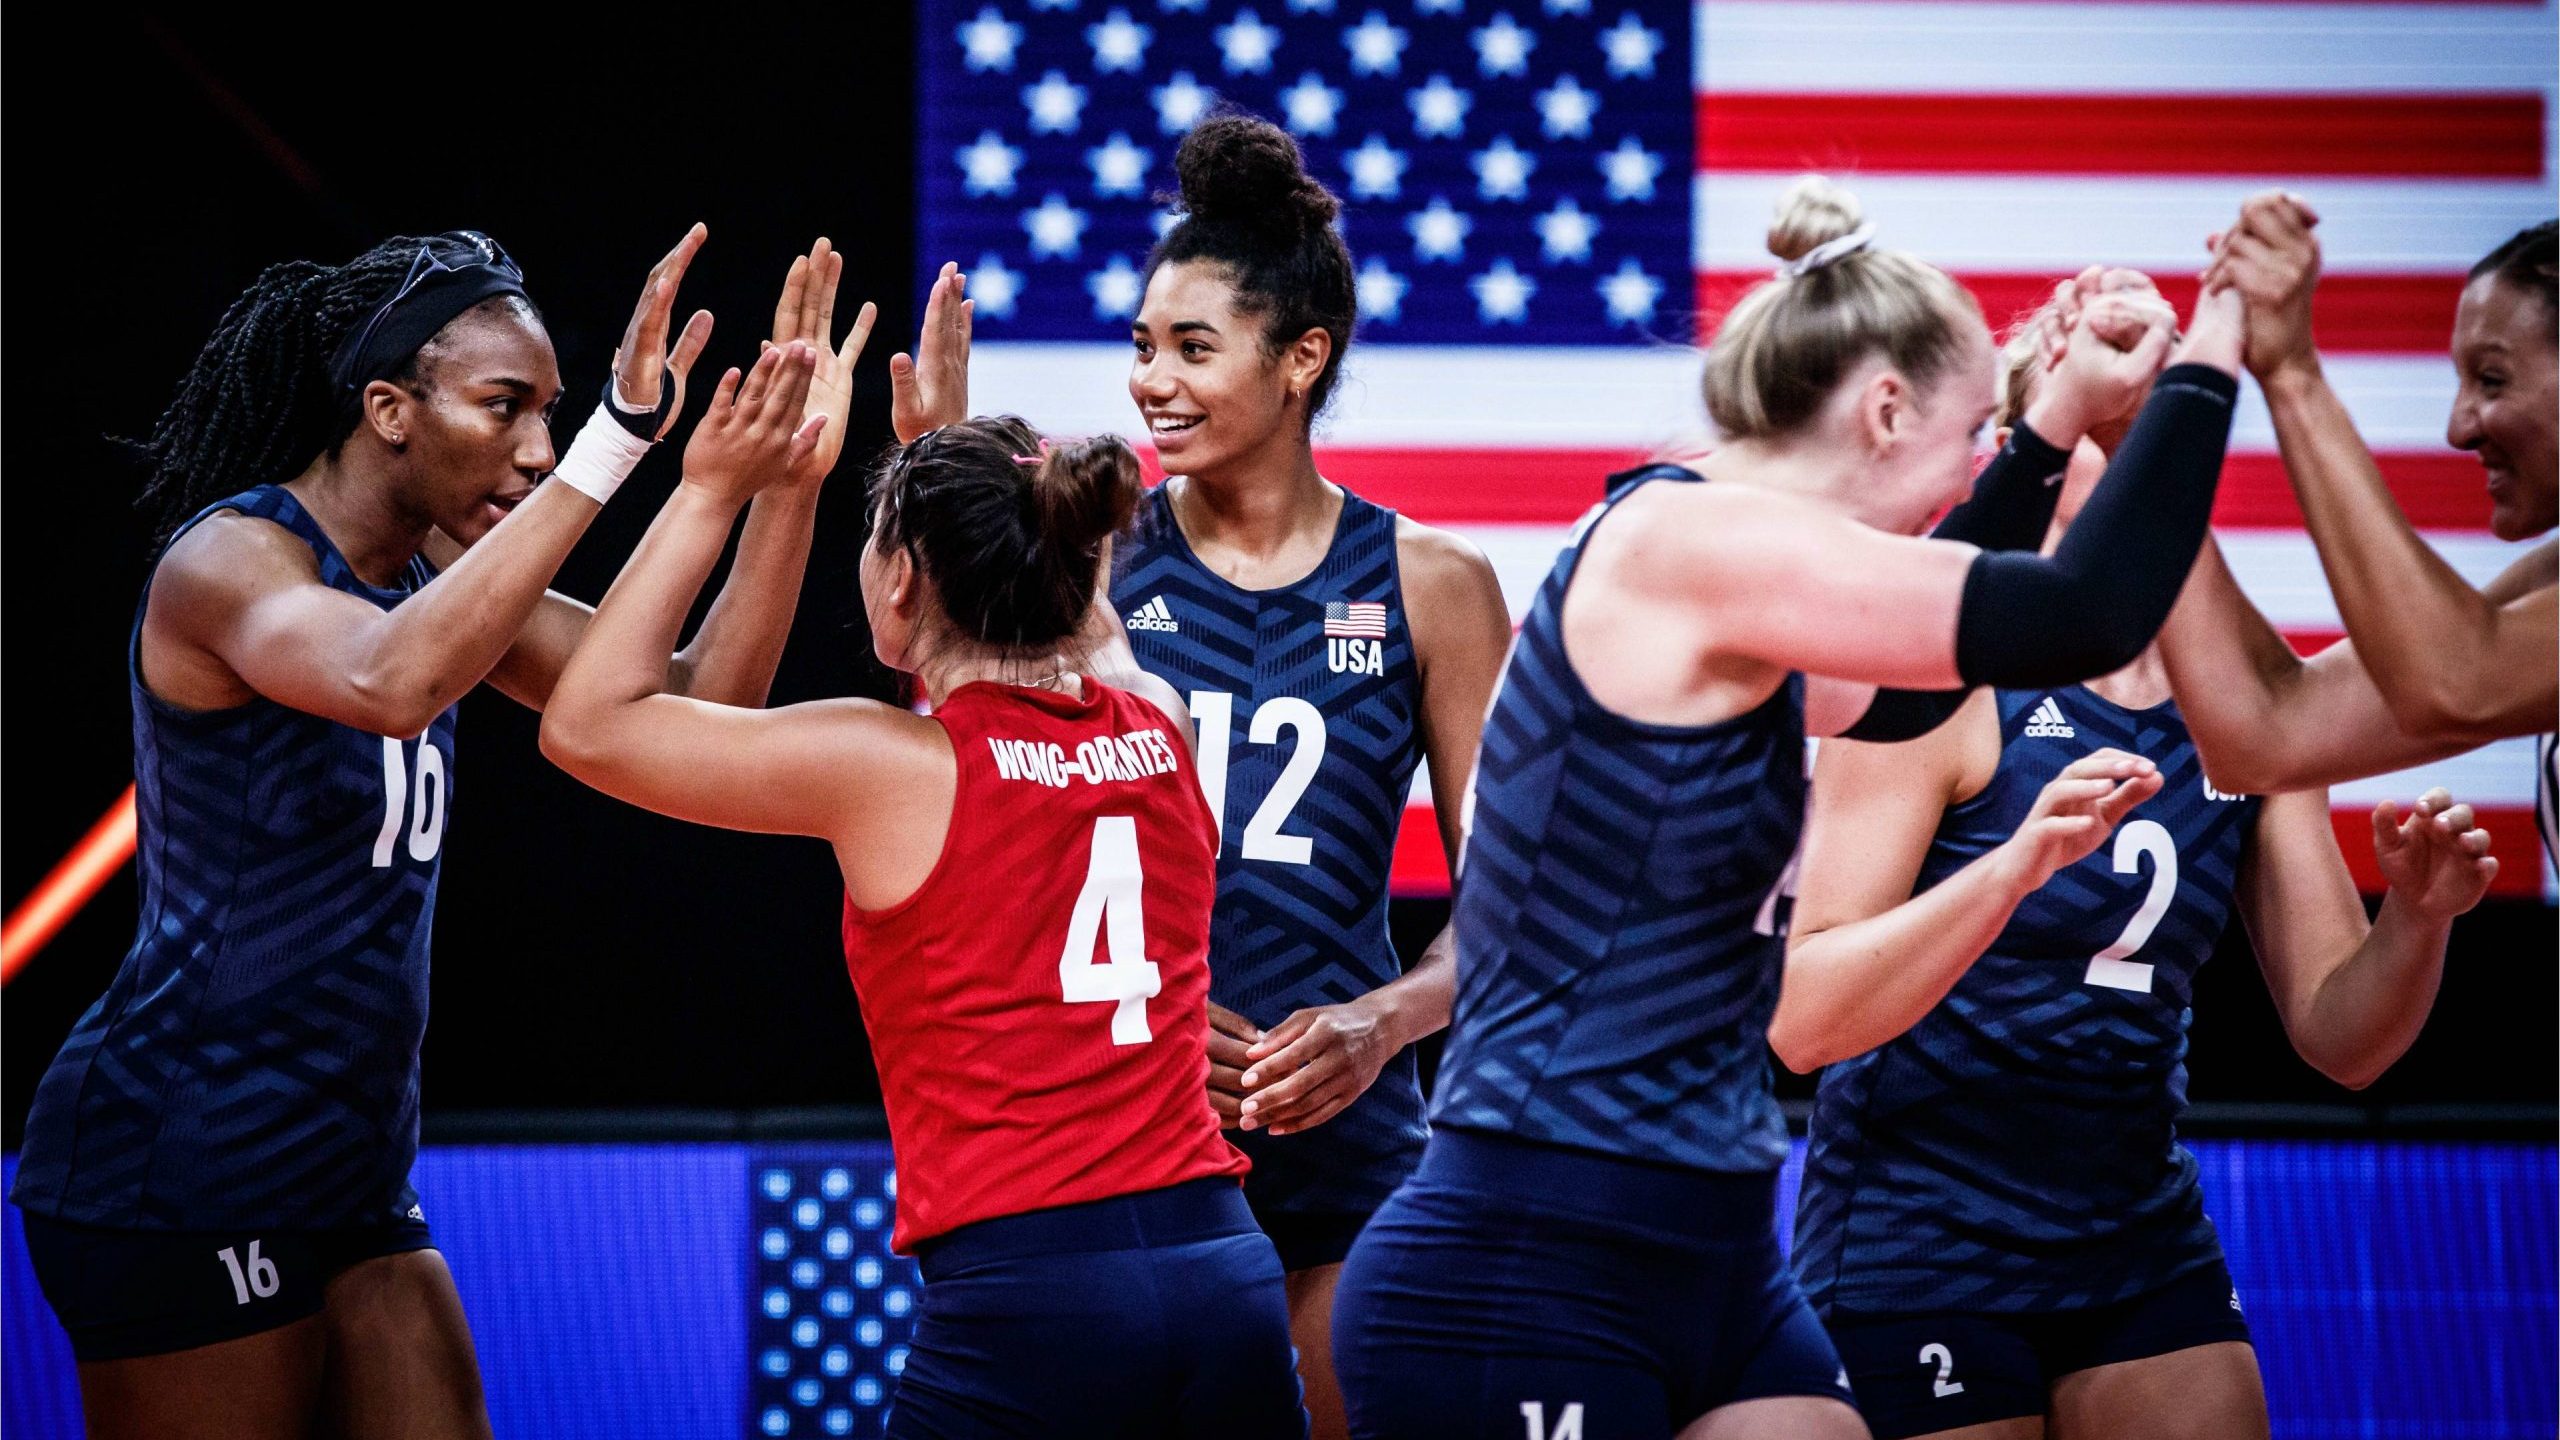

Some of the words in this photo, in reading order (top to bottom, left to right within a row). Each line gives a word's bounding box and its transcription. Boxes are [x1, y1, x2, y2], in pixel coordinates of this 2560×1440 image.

[1126, 615, 1178, 633] adidas
[1328, 638, 1384, 677] USA
[2024, 722, 2075, 738] adidas
[372, 726, 445, 868] 16
[1189, 690, 1327, 866] 12
[1059, 816, 1162, 1046] 4
[2084, 819, 2178, 994] 2
[217, 1239, 280, 1305] 16
[1919, 1342, 1965, 1398] 2
